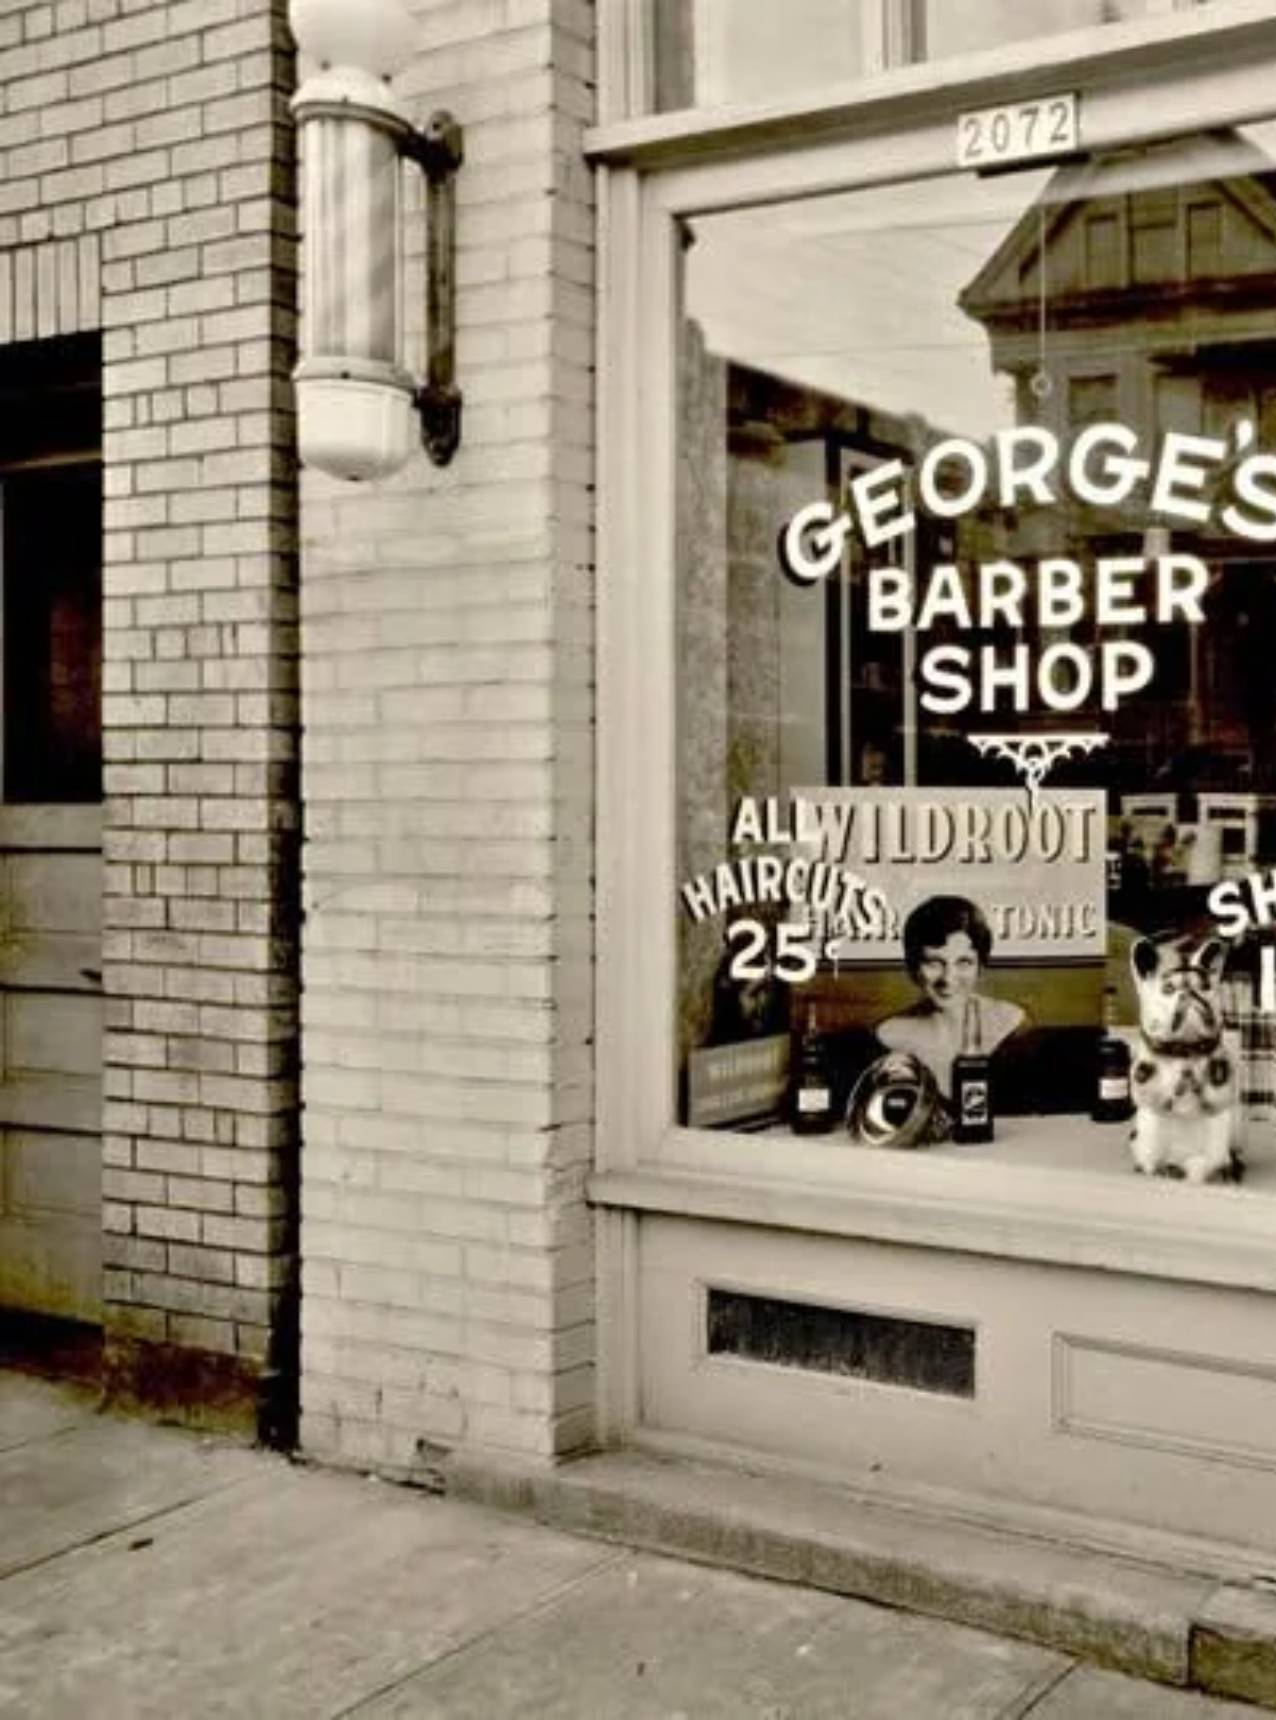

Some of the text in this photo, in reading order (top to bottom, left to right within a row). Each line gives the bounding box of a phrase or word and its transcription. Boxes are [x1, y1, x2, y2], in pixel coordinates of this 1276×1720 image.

[963, 100, 1069, 158] 2072
[867, 555, 1210, 632] BARBER
[919, 641, 1155, 714] SHOP
[732, 796, 825, 844] ALL
[812, 800, 1098, 864] WILDROOT
[680, 854, 889, 936] HAIRCUTS
[992, 902, 1098, 941] TONIC
